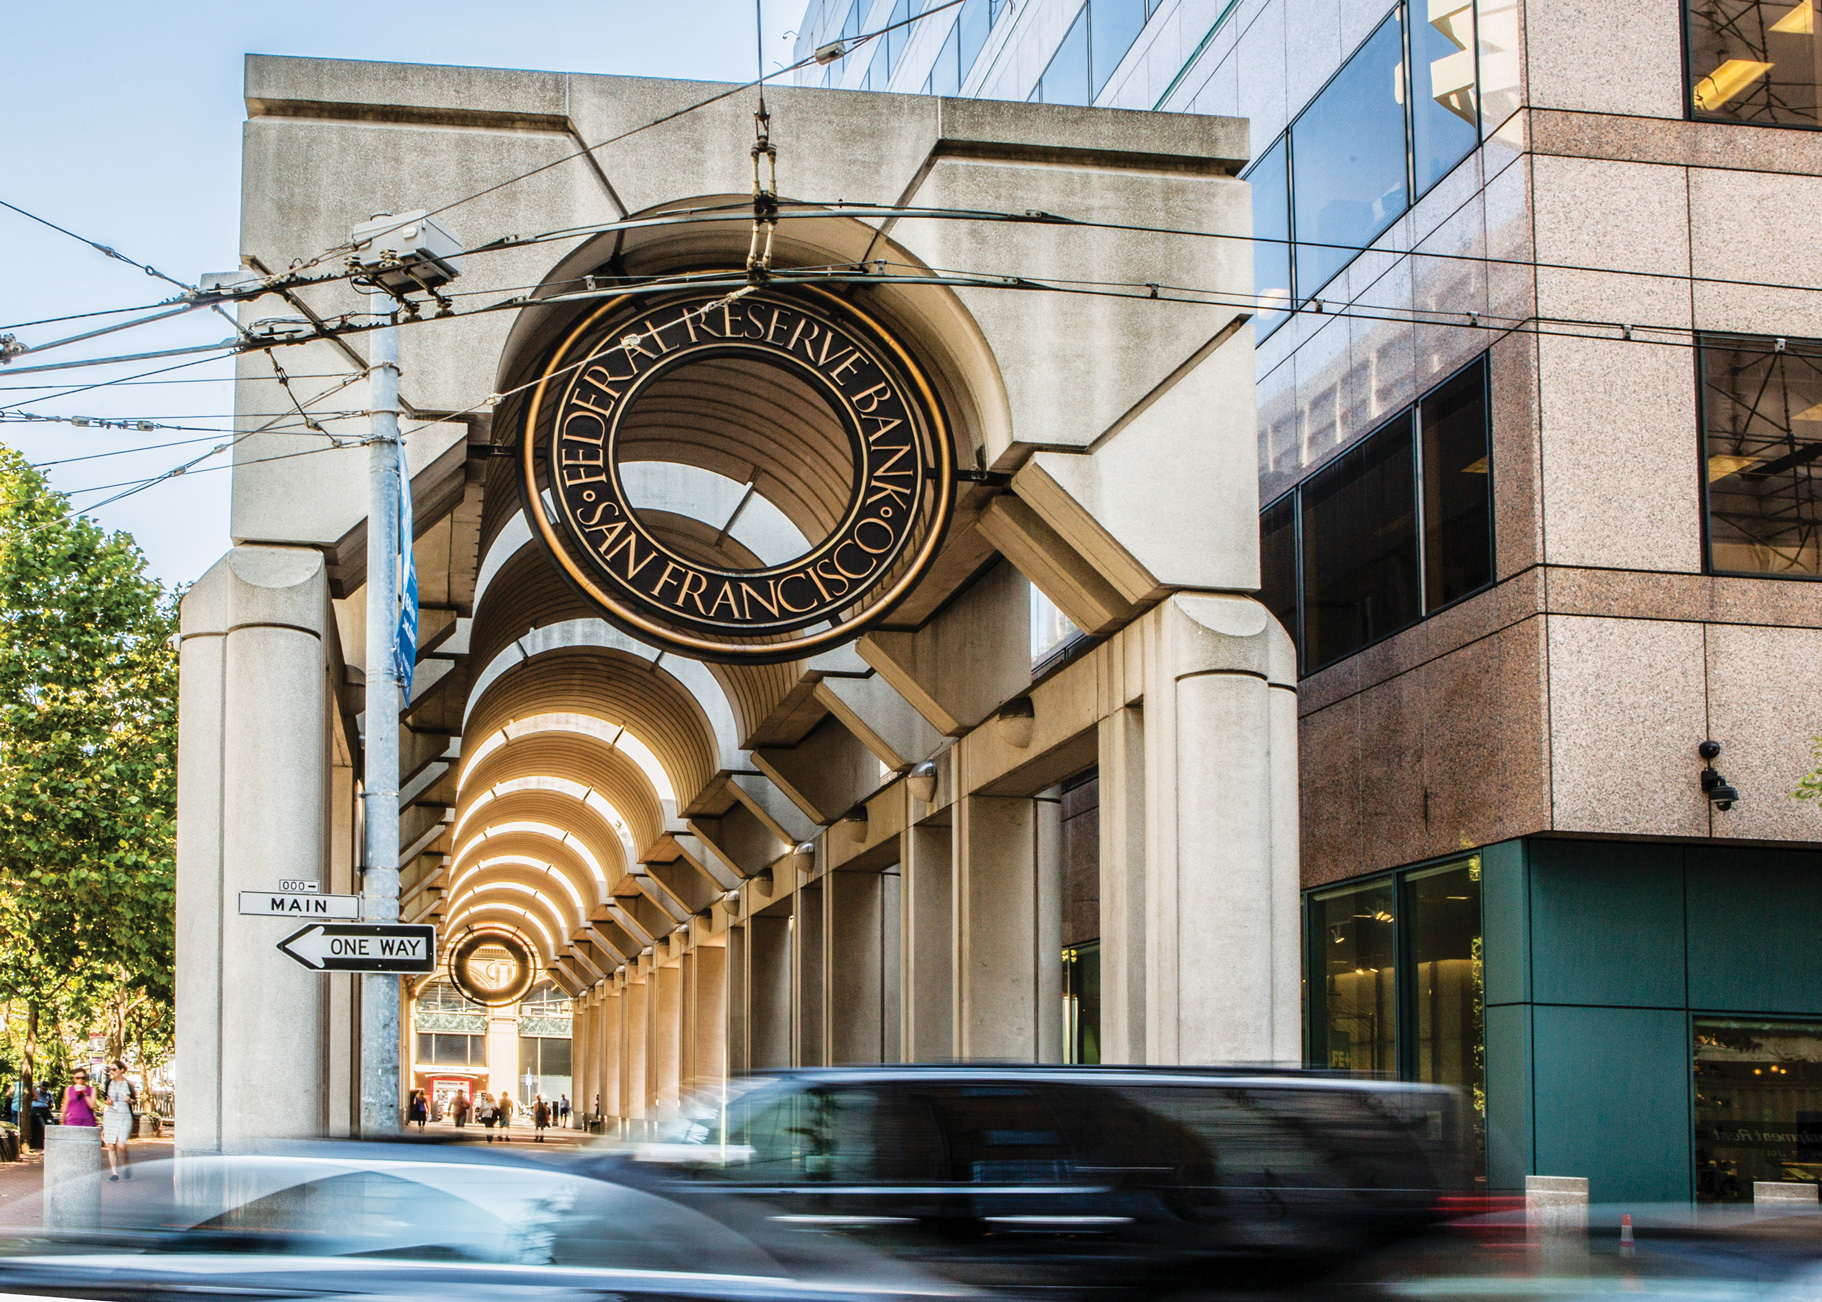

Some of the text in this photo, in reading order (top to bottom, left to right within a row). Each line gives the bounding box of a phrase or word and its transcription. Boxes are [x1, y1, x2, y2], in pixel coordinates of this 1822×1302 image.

[562, 301, 913, 511] FEDERAL RESERVE BANK
[576, 501, 894, 620] SAN FRANCISCO
[271, 898, 327, 913] MAIN
[330, 938, 421, 956] ONE WAY
